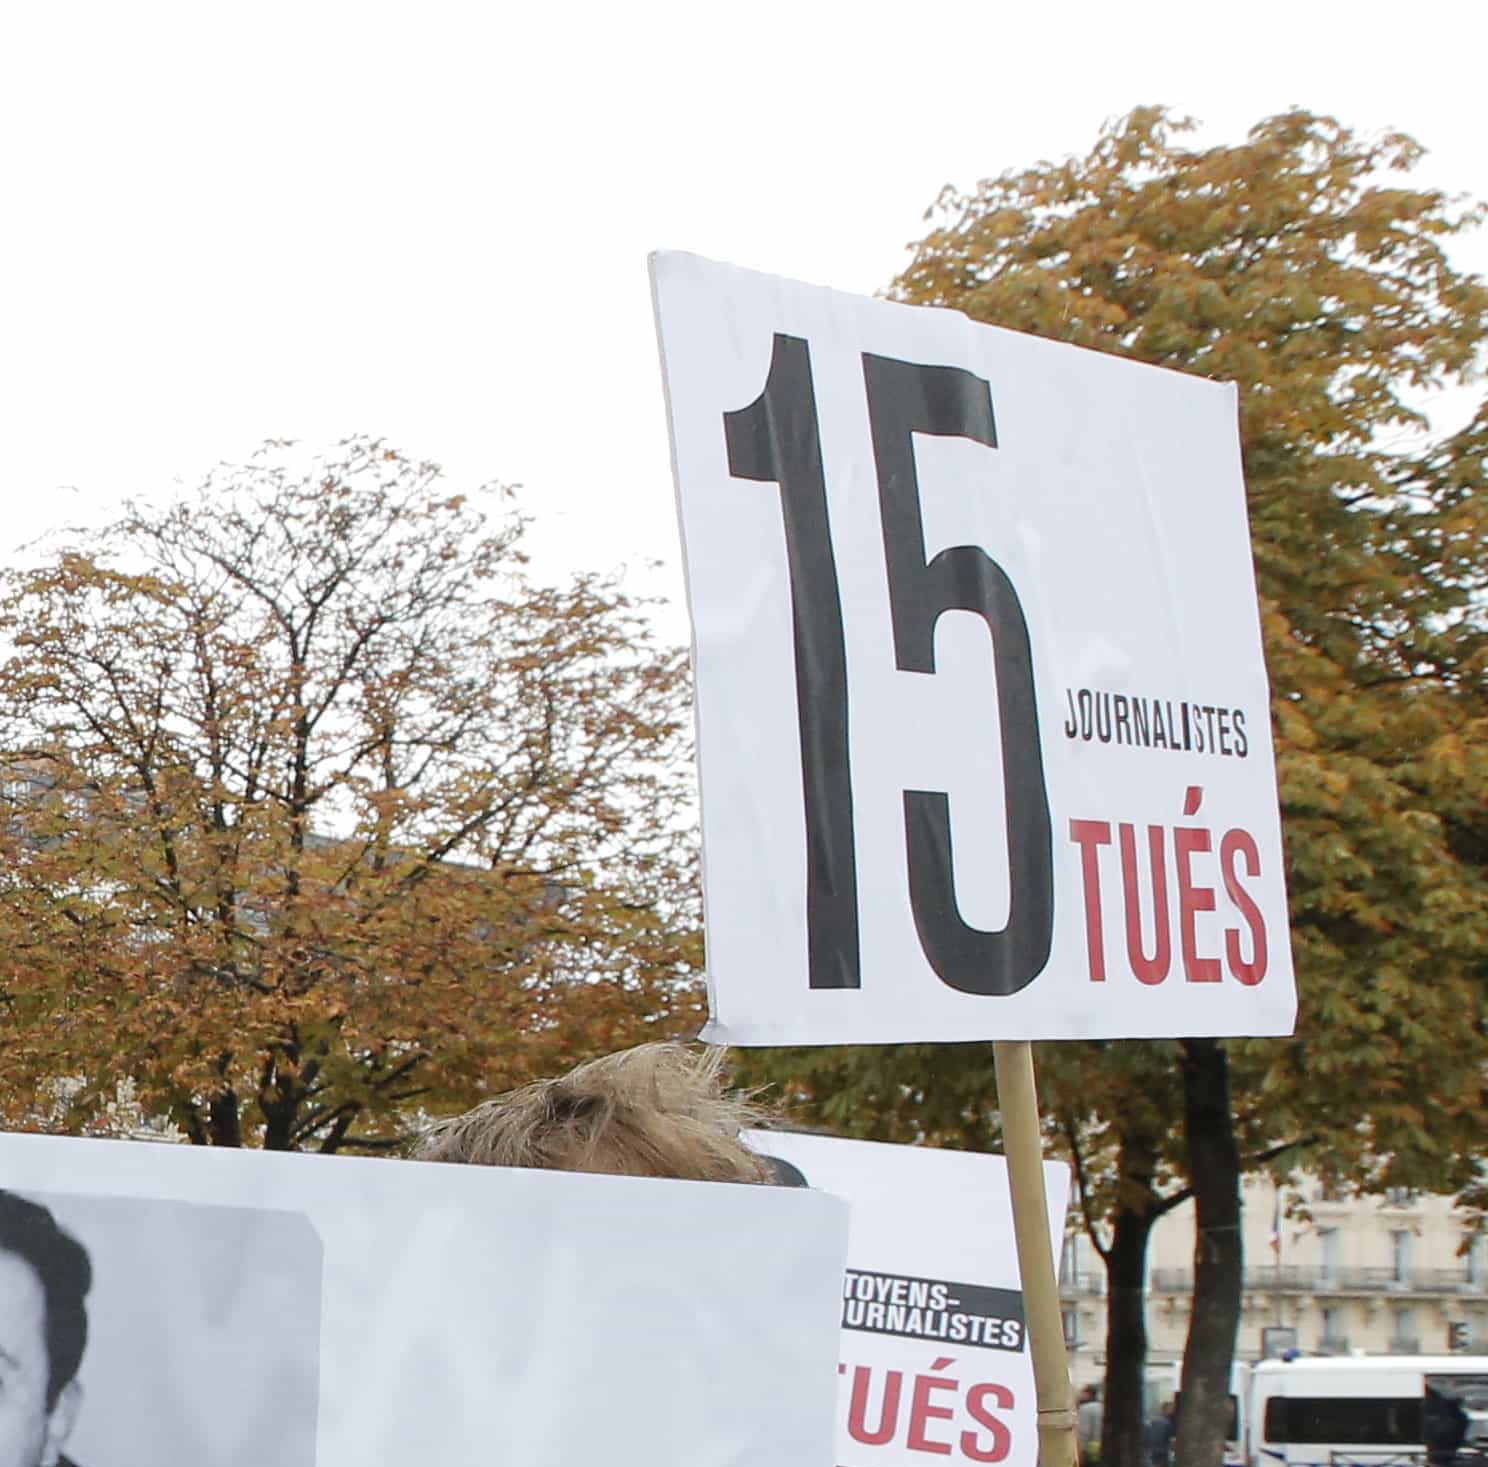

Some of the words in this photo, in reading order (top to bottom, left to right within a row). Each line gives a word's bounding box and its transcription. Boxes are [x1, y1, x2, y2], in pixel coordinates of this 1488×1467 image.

[724, 332, 1054, 996] 15
[1065, 689, 1248, 757] JOURNALISTES
[1070, 786, 1268, 987] TUÉS
[842, 1300, 1021, 1347] URNALISTES
[838, 1356, 1015, 1464] UÉS
